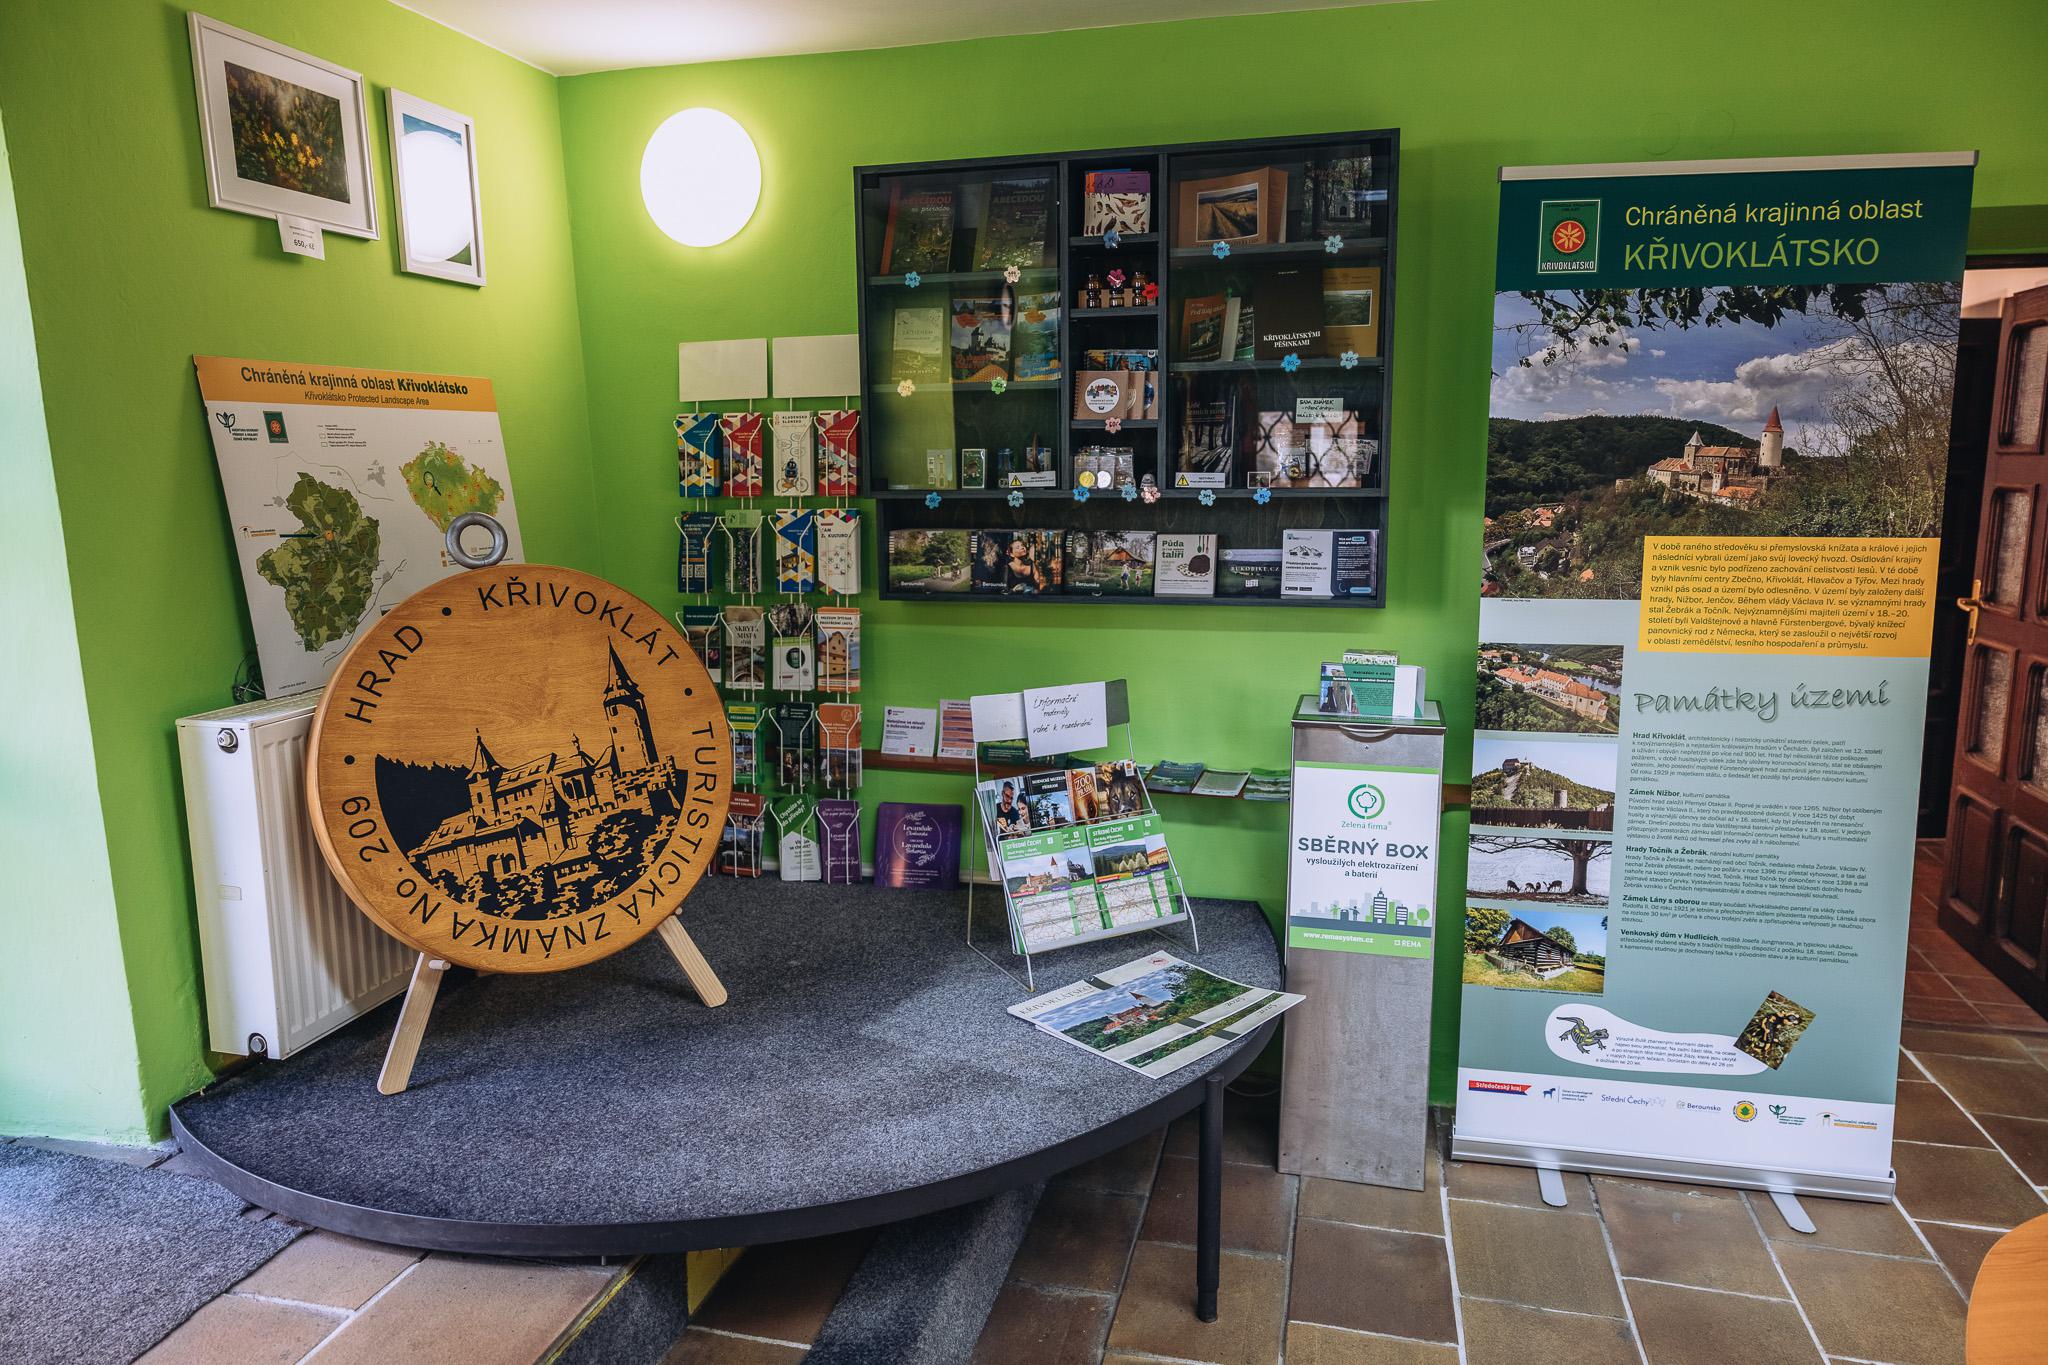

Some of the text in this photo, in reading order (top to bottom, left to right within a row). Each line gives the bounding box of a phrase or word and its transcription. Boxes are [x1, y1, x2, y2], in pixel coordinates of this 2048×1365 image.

[1625, 199, 1923, 226] Chráněná krajinná oblast
[1624, 233, 1880, 270] KŘIVOKLÁTSKO
[1264, 331, 1320, 341] KŘIVOKLÁTSKÝMI
[1274, 339, 1310, 348] PĚŠINKAMI
[241, 366, 468, 395] Chráněná krajinná oblast Křivoklátsko
[305, 391, 429, 406] Křivoklátsko Protected Landscape Area
[1162, 539, 1184, 547] Půda
[1659, 542, 1681, 552] době
[1682, 542, 1712, 552] raného
[1713, 543, 1758, 552] středověku
[1769, 543, 1826, 553] přemyslovská
[1828, 543, 1859, 553] knížata
[1868, 544, 1899, 554] králové
[1904, 544, 1927, 553] jejich
[1652, 552, 1922, 565] následníci vybrali území jako svůj lovecký hvozd. Osídlování krajiny
[478, 576, 680, 668] KŘIVOKLÁT
[1653, 636, 1680, 645] oblasti
[1682, 636, 1732, 647] zemědělství,
[1734, 637, 1764, 646] lesního
[1766, 638, 1818, 648] hospodaření
[1827, 639, 1868, 650] průmyslu.
[345, 625, 423, 723] HRAD
[1634, 679, 1890, 722] Památky území
[1632, 731, 1650, 740] Hrad
[1075, 775, 1090, 789] ZOO
[1629, 788, 1654, 797] Zámek
[1341, 821, 1366, 829] Zelená
[341, 722, 718, 958] TURISTICKÁ ZNÁMKA No. 209
[1298, 835, 1429, 859] SBĚRNÝ BOX
[1625, 846, 1648, 855] Hrady
[1648, 846, 1673, 855] Točník
[1306, 857, 1418, 871] vysloužilých elektrozařízení
[1352, 870, 1378, 879] baterií
[1622, 894, 1648, 903] Zámek
[1649, 895, 1667, 905] Lány
[1674, 897, 1700, 906] oborou
[1304, 932, 1421, 948] www.remasystem.cz REMA
[1620, 929, 1658, 939] Venkovský
[1660, 930, 1676, 938] dům
[1684, 932, 1719, 942] Hudlicích,
[1476, 1082, 1510, 1091] Středočeský
[1601, 1094, 1626, 1103] Střední
[1627, 1094, 1650, 1106] Čechy
[1687, 1102, 1721, 1112] Berounsko
